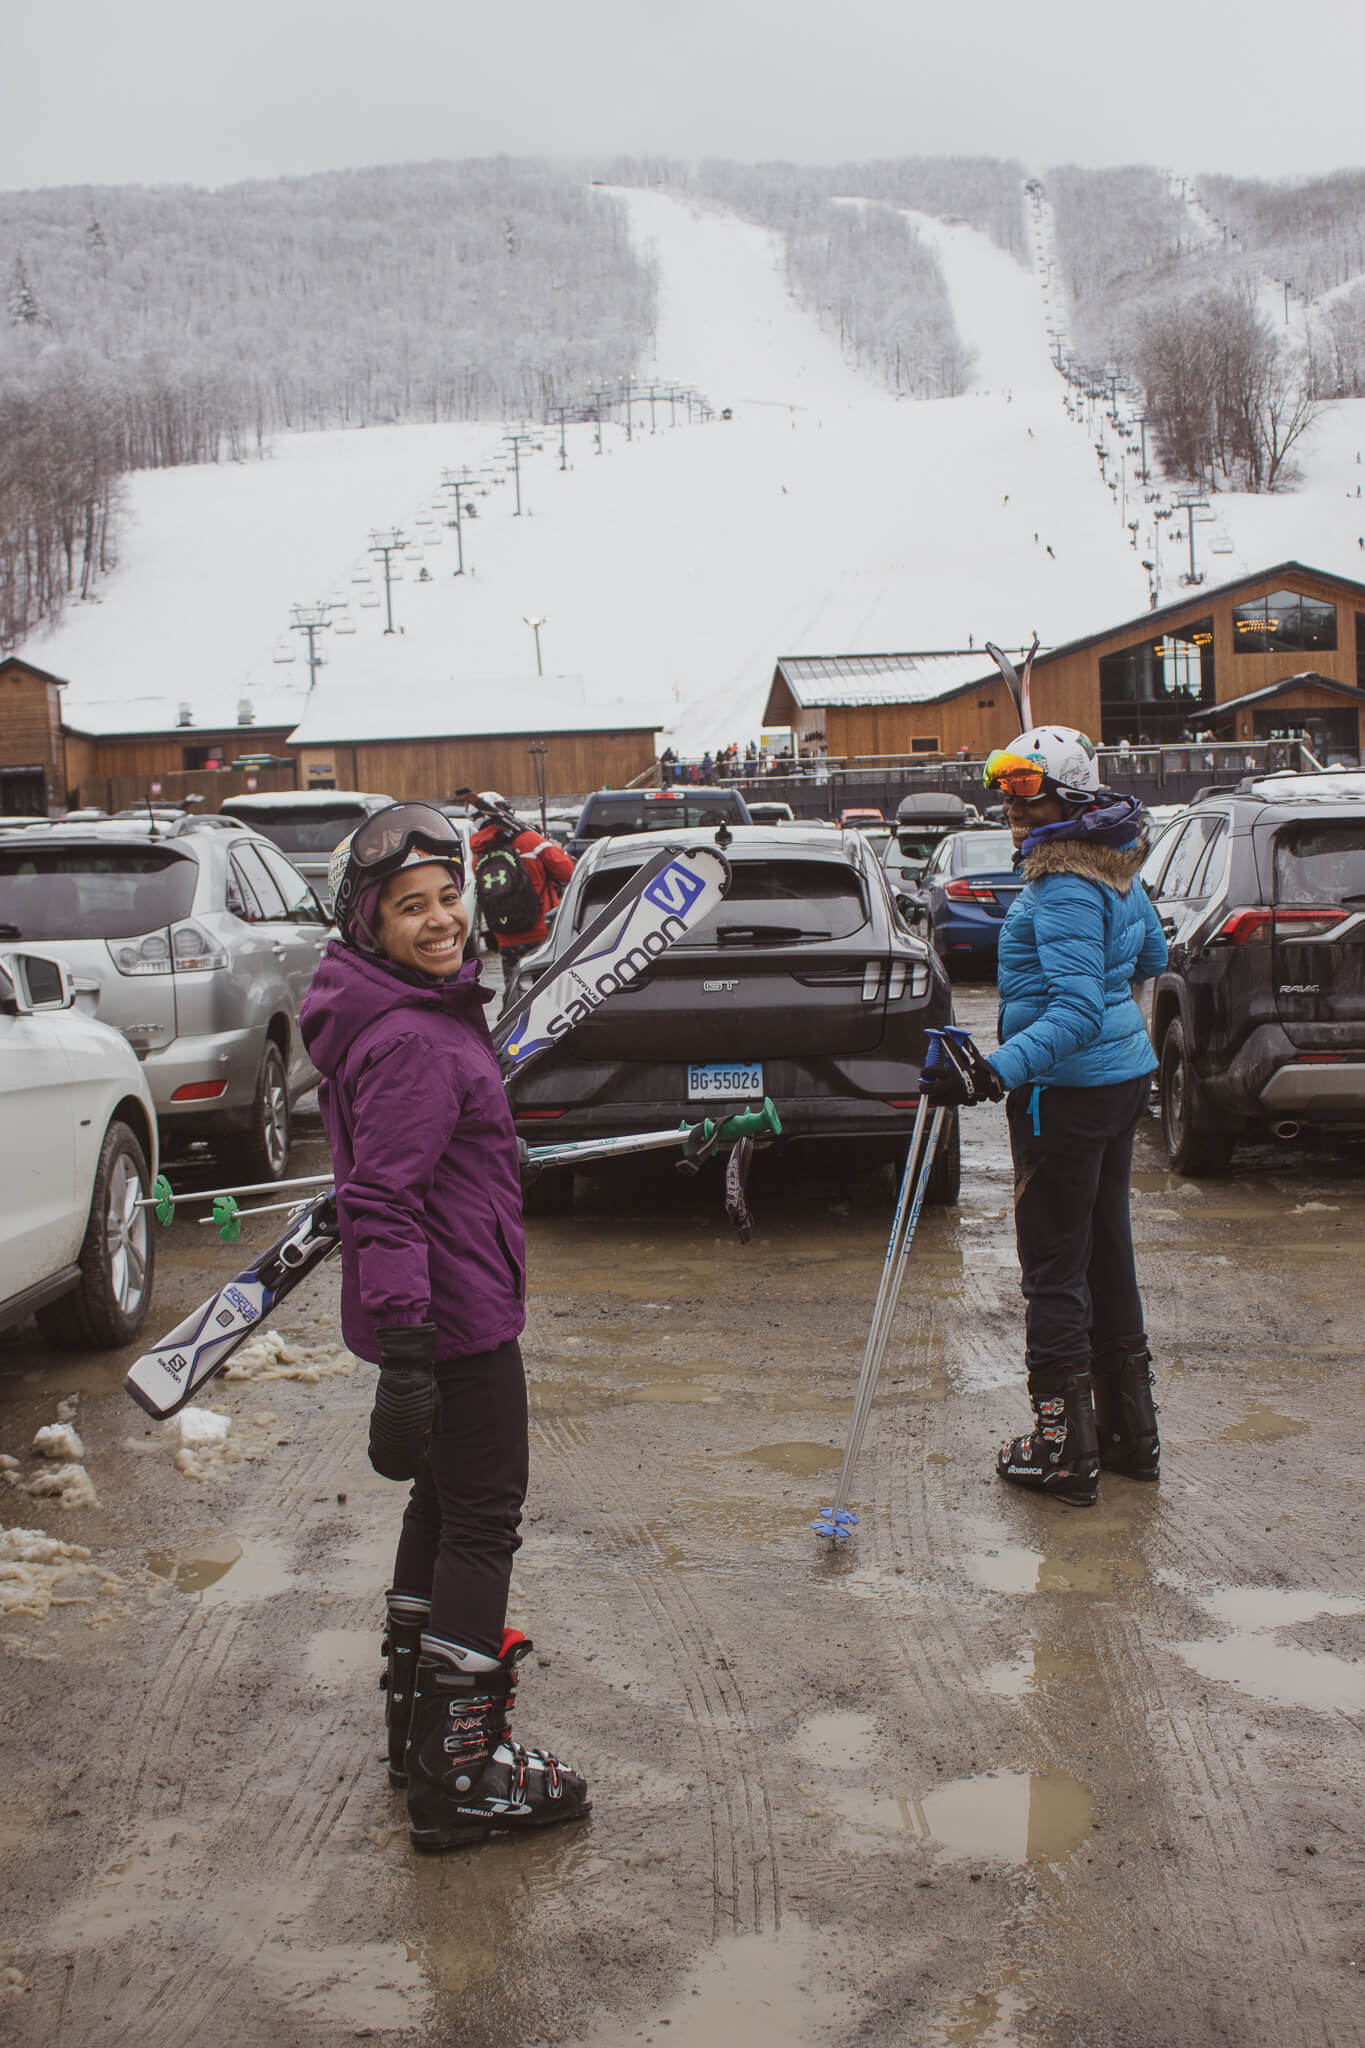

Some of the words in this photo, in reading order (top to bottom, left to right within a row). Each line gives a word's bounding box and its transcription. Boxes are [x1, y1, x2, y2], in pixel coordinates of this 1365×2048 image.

[704, 980, 739, 991] GT
[726, 1158, 740, 1208] SCOTT
[225, 1287, 258, 1320] FOCUS
